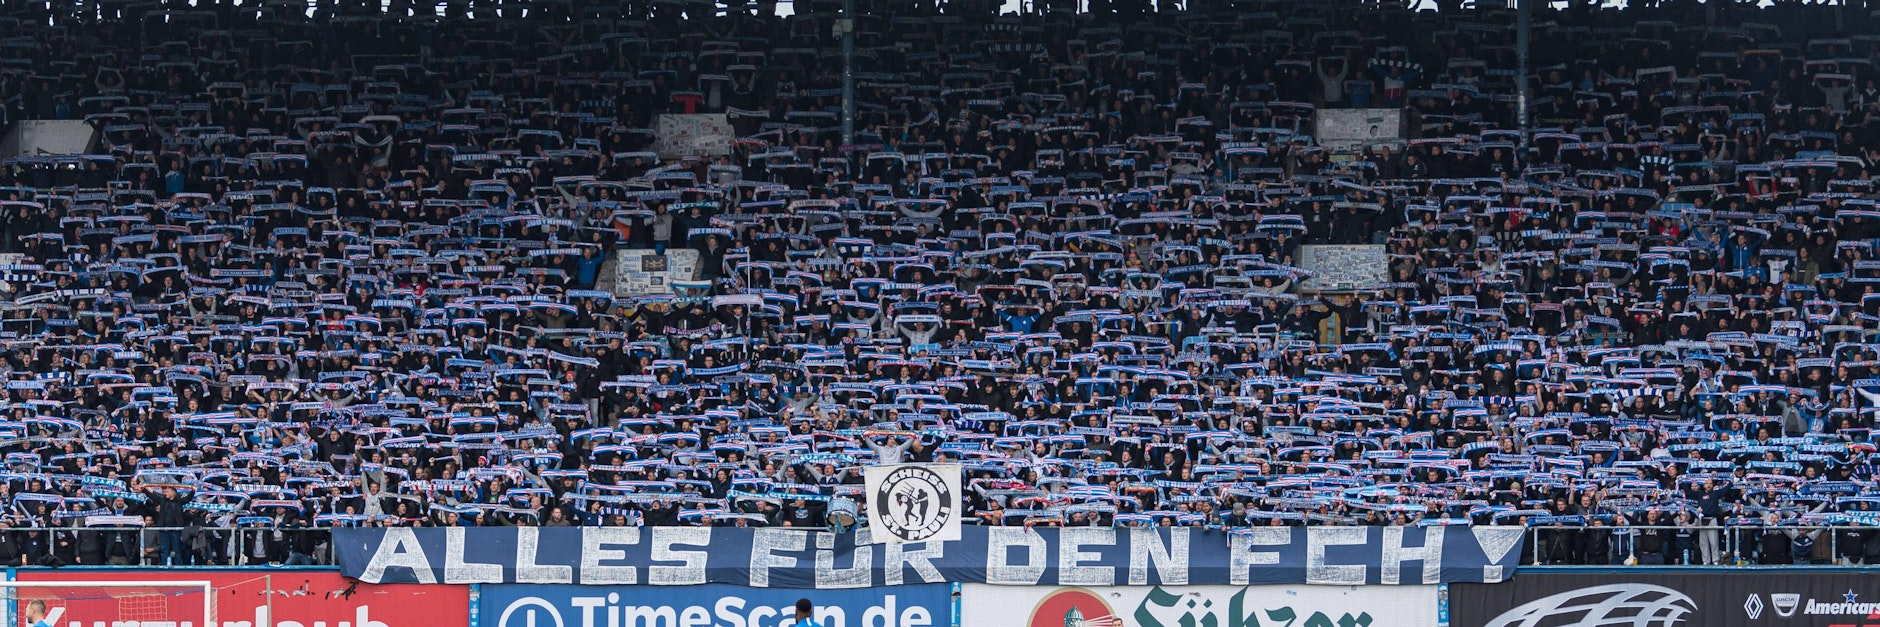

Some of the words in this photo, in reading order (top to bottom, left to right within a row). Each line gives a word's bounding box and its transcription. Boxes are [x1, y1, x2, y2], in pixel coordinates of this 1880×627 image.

[881, 468, 948, 495] SCHEISS
[881, 514, 903, 536] ST.
[907, 506, 952, 541] PAULI
[358, 526, 711, 586] ALLES
[750, 528, 948, 589] FÜR
[986, 526, 1190, 585] DEN
